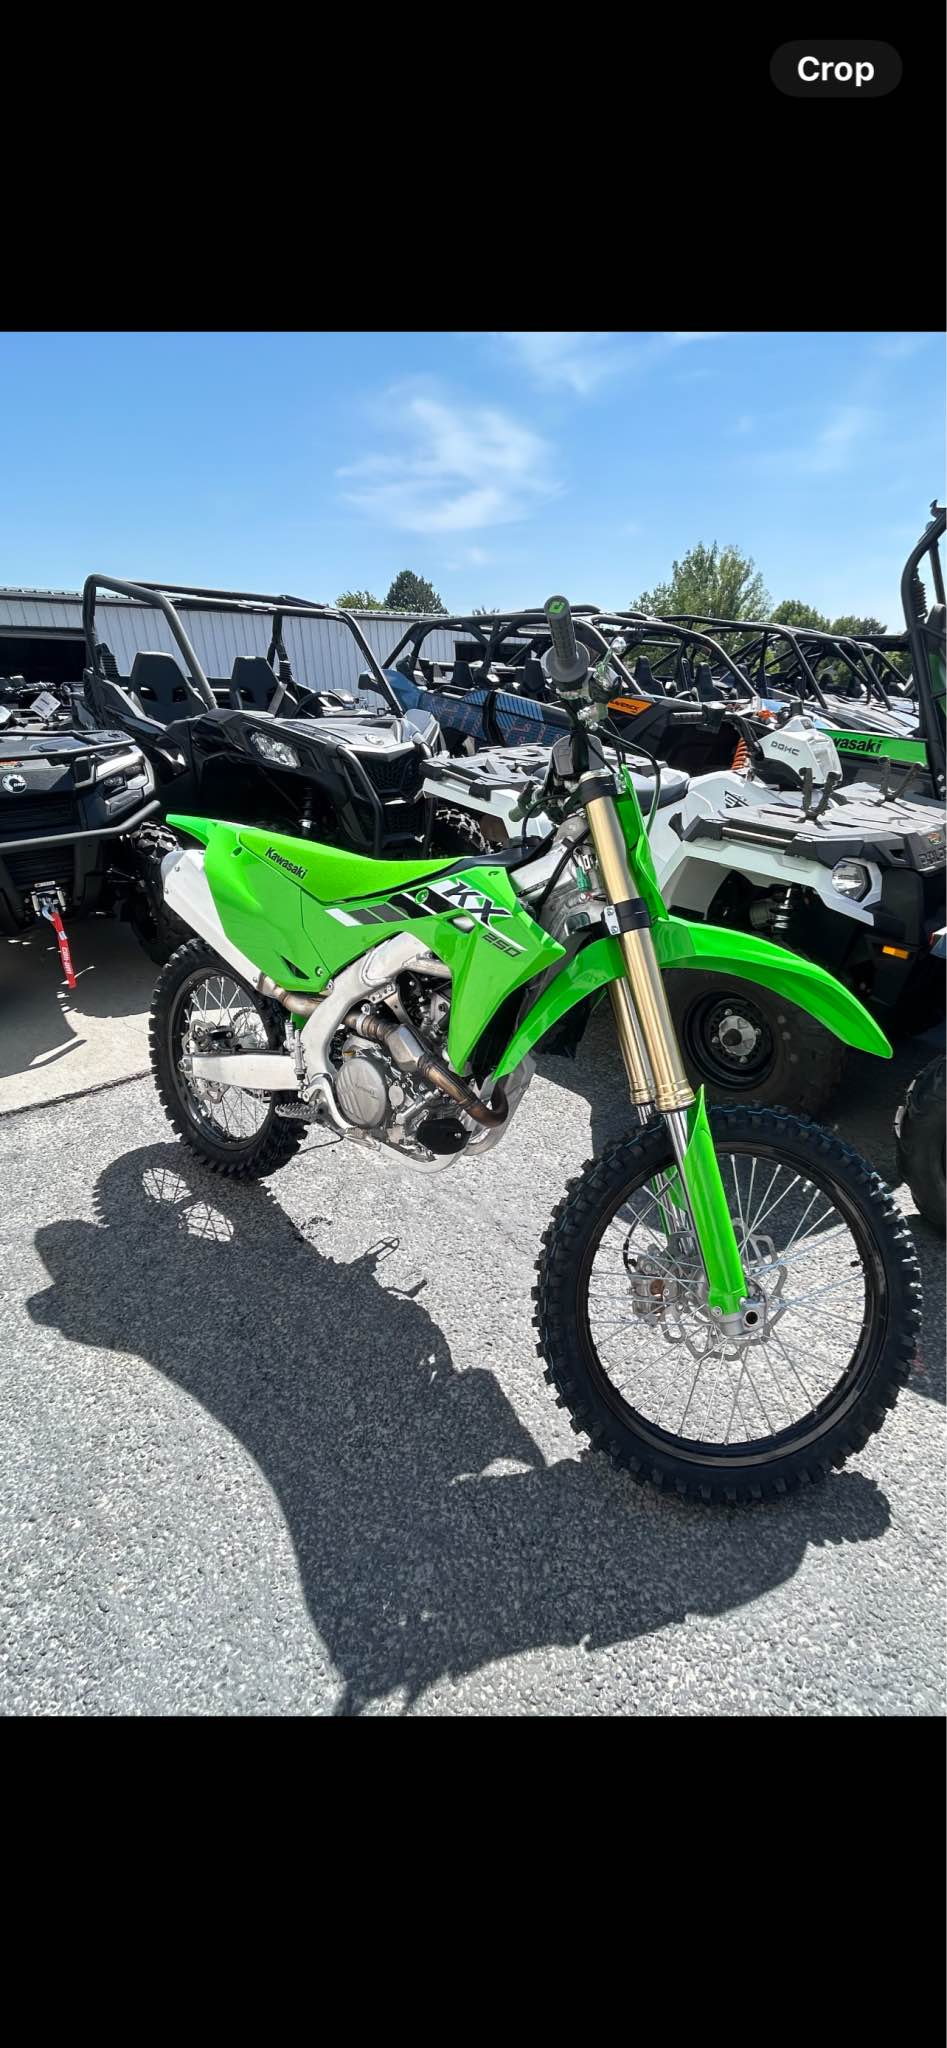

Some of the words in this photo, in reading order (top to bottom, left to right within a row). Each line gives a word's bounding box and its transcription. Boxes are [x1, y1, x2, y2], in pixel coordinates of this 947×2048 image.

[834, 738, 882, 753] wasaki
[265, 847, 308, 879] Kawasaki
[441, 881, 512, 927] KX
[482, 932, 522, 958] 250
